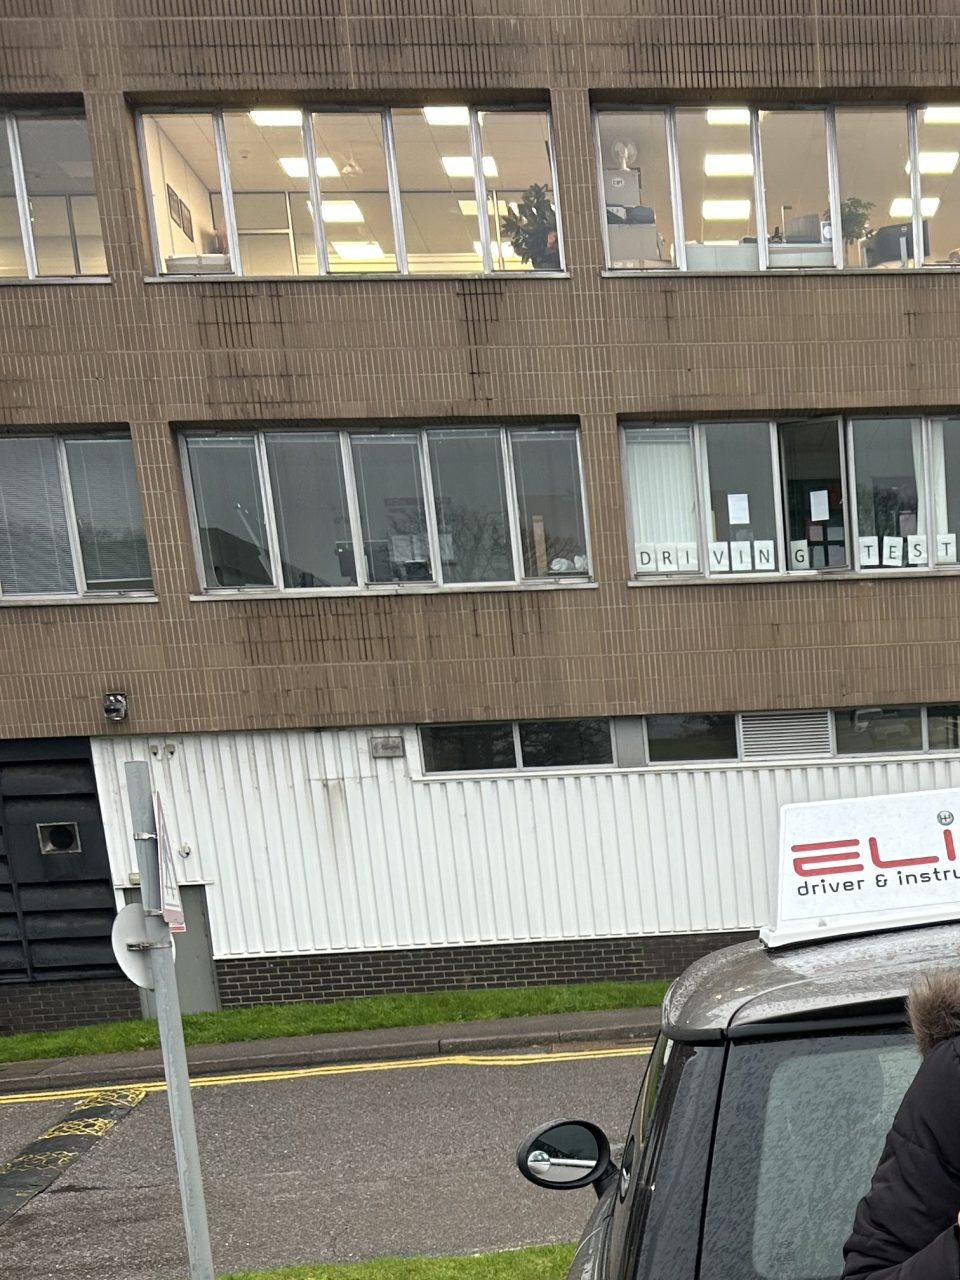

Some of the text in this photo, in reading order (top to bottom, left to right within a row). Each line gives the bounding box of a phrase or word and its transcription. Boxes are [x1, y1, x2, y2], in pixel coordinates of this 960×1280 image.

[864, 542, 951, 560] TEST
[797, 876, 864, 896] driver
[874, 871, 888, 888] &
